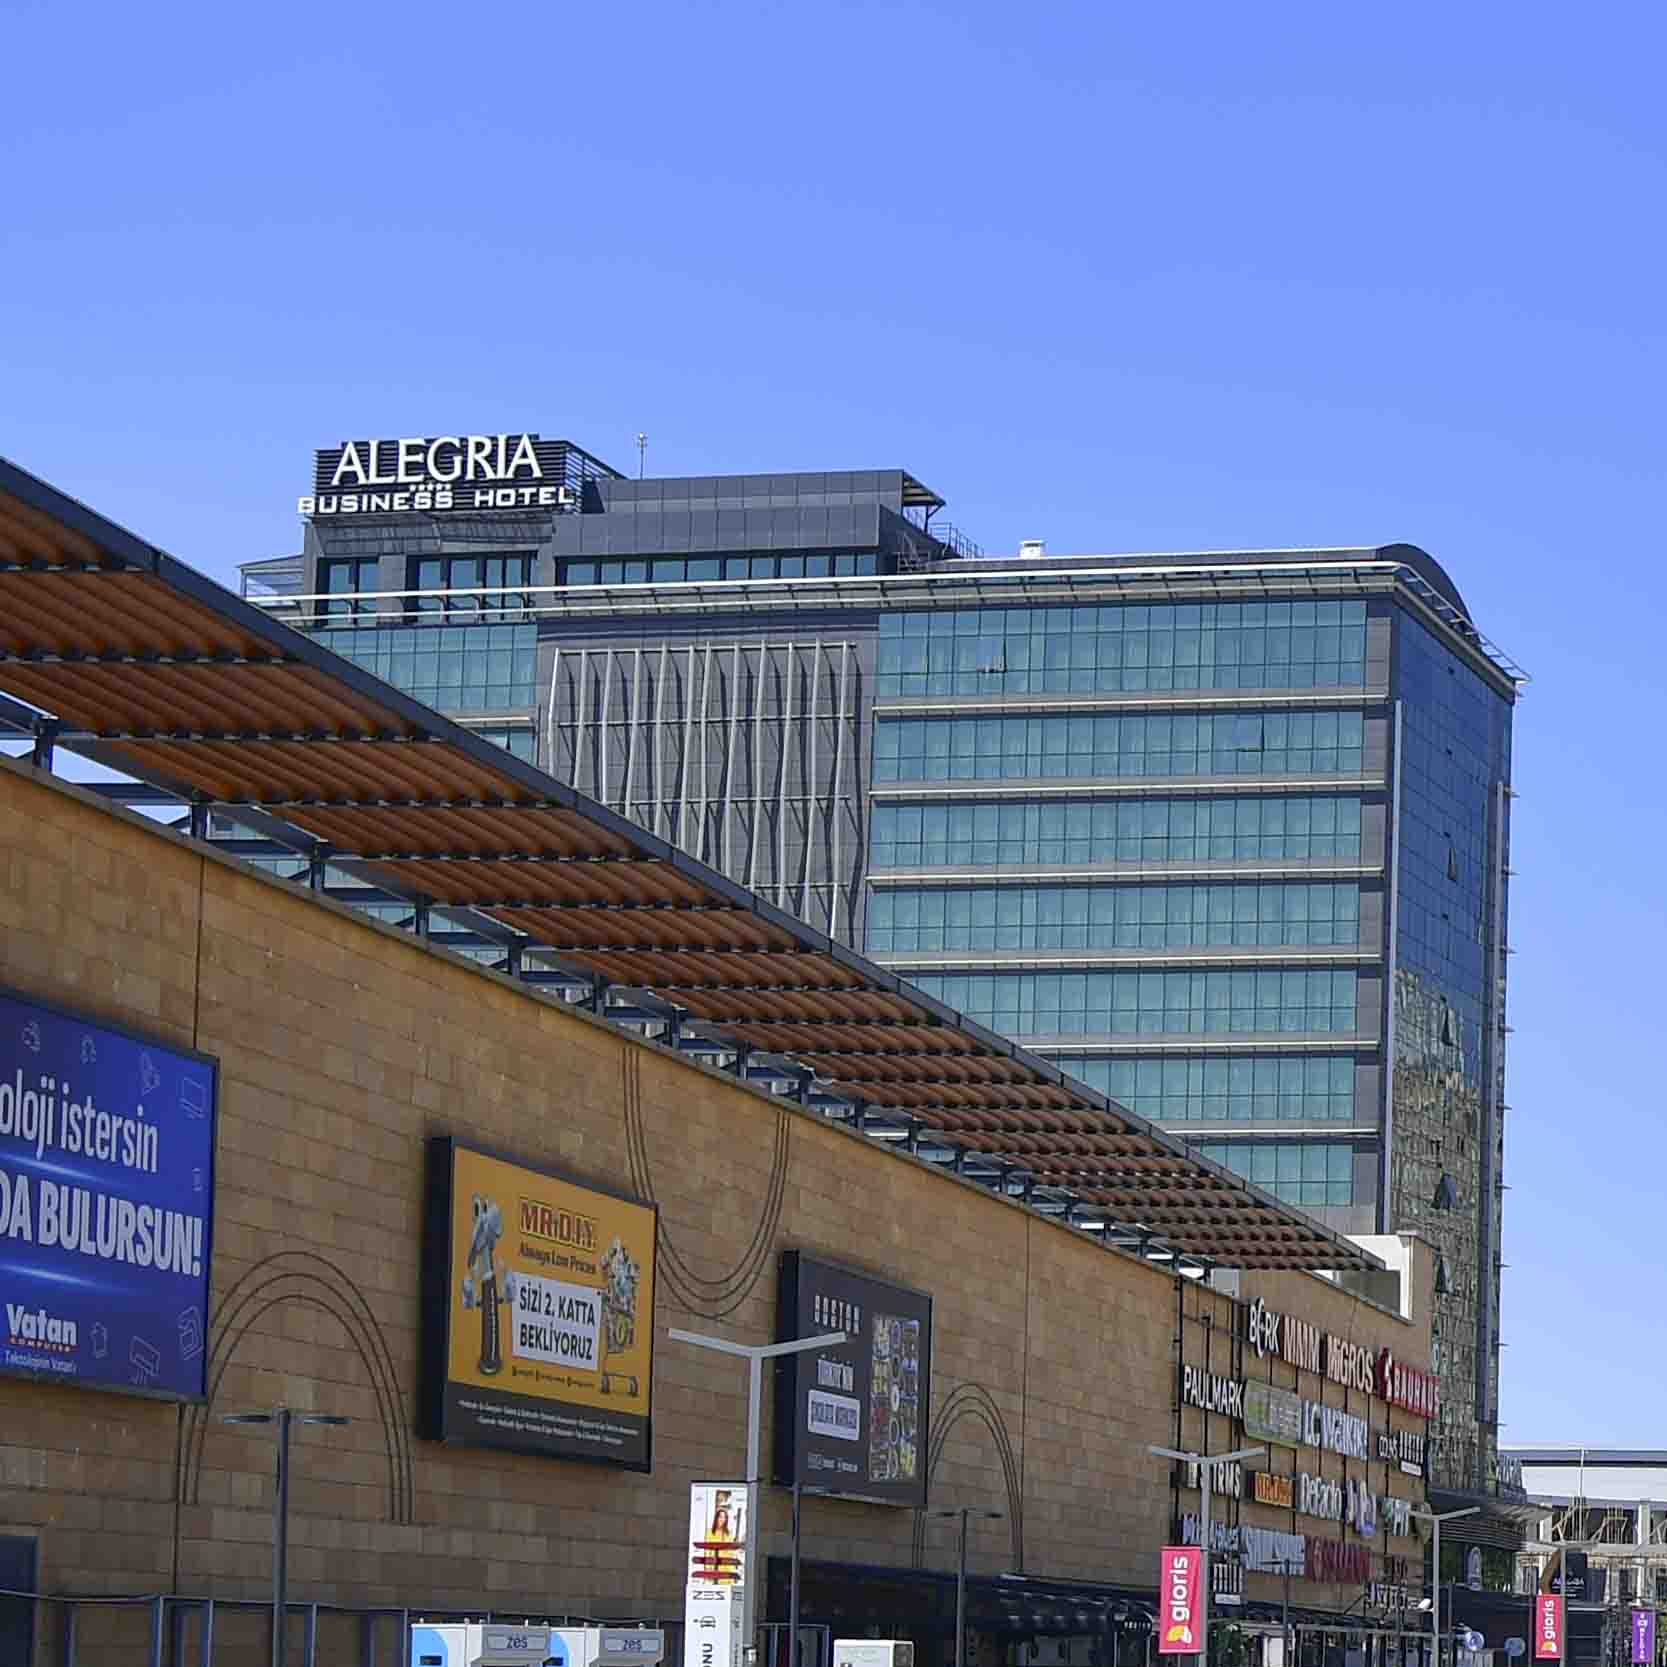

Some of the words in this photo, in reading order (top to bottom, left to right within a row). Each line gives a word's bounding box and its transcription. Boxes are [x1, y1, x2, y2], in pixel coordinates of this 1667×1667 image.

[331, 433, 543, 486] ALEGRIA
[297, 491, 454, 514] BUSINESS
[474, 487, 575, 508] HOTEL
[61, 1082, 158, 1173] istersin
[38, 1180, 203, 1277] BULURSUN!
[6, 1304, 77, 1345] Vatan
[558, 1296, 595, 1327] KATTA
[520, 1321, 593, 1361] BEKLİYORUZ
[1183, 1365, 1244, 1419] PAULMARK
[1169, 1556, 1190, 1621] gloris
[1543, 1599, 1556, 1640] gloris
